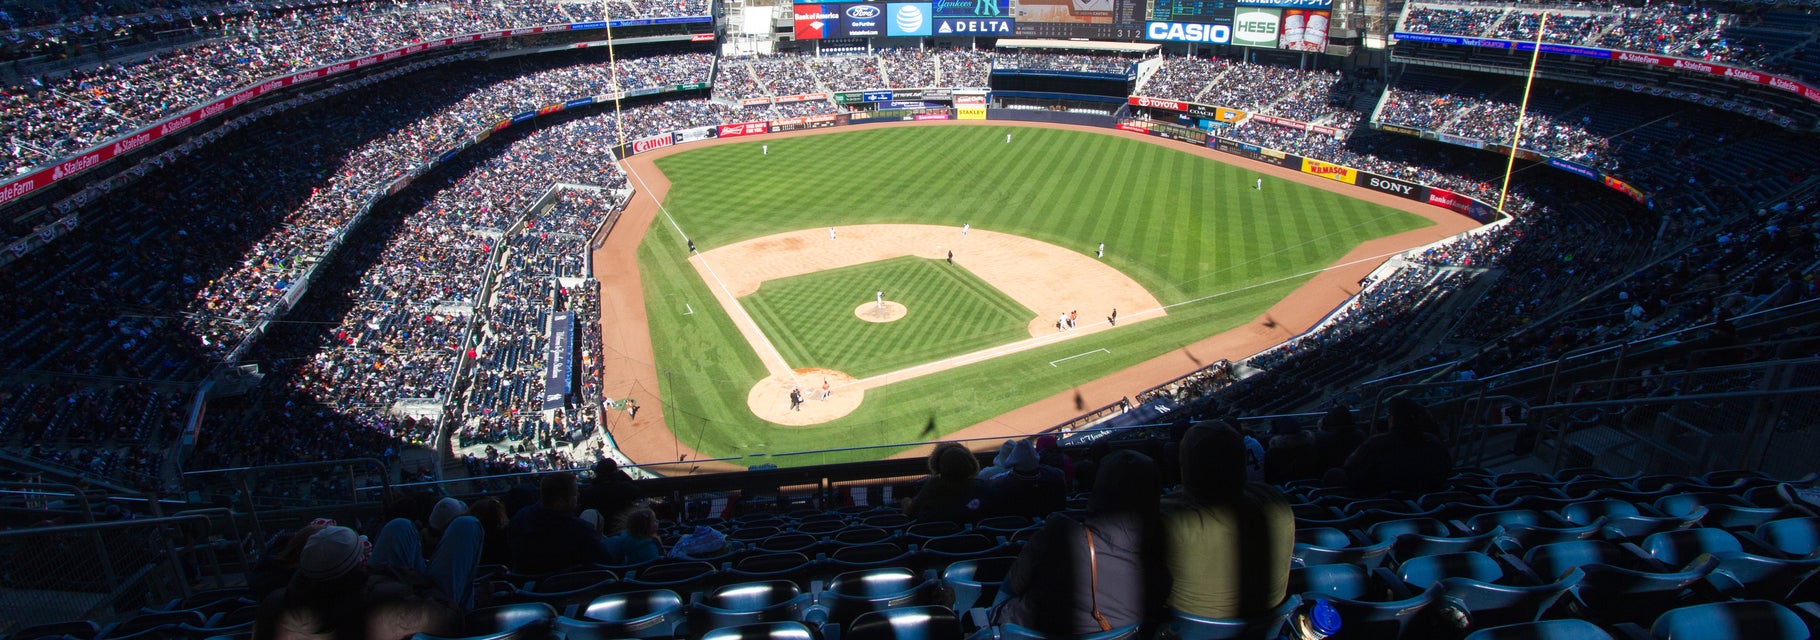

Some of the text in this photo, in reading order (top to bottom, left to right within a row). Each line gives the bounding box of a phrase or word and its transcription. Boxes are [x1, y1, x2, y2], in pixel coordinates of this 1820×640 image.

[853, 7, 873, 17] Ford
[937, 0, 972, 13] Yankees
[956, 21, 1009, 32] DELTA
[1238, 21, 1276, 33] HESS
[1149, 22, 1230, 43] CASIO
[1151, 99, 1179, 110] TOYOTA
[1189, 109, 1214, 117] COACH
[633, 135, 672, 153] Canon
[1370, 177, 1413, 195] SONY
[1430, 194, 1447, 205] Bank
